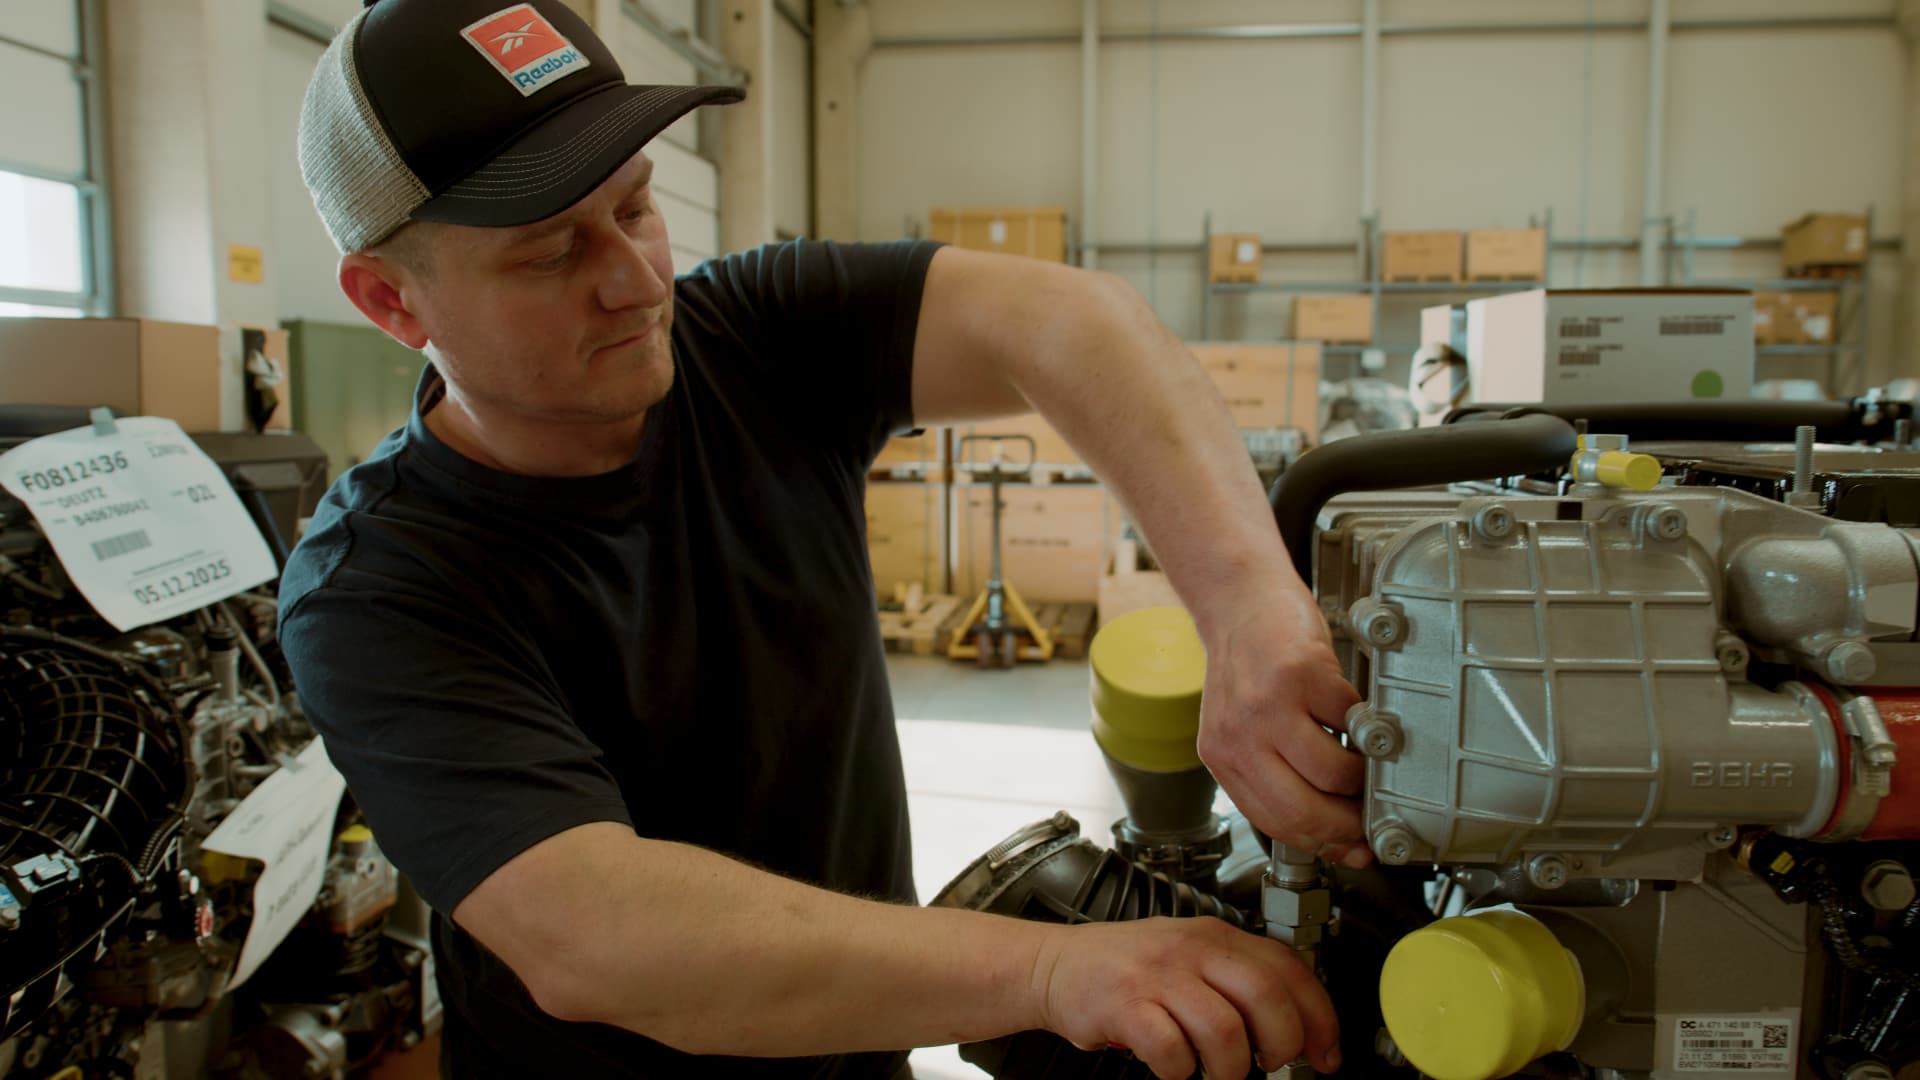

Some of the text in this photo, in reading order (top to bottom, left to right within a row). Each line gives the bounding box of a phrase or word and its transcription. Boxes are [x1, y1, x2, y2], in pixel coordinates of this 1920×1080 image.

[513, 49, 578, 88] Reebok
[20, 450, 129, 493] F0812436
[56, 486, 108, 509] DEUTZ
[132, 559, 233, 606] 05.12.2025
[1690, 761, 1793, 788] BEHR
